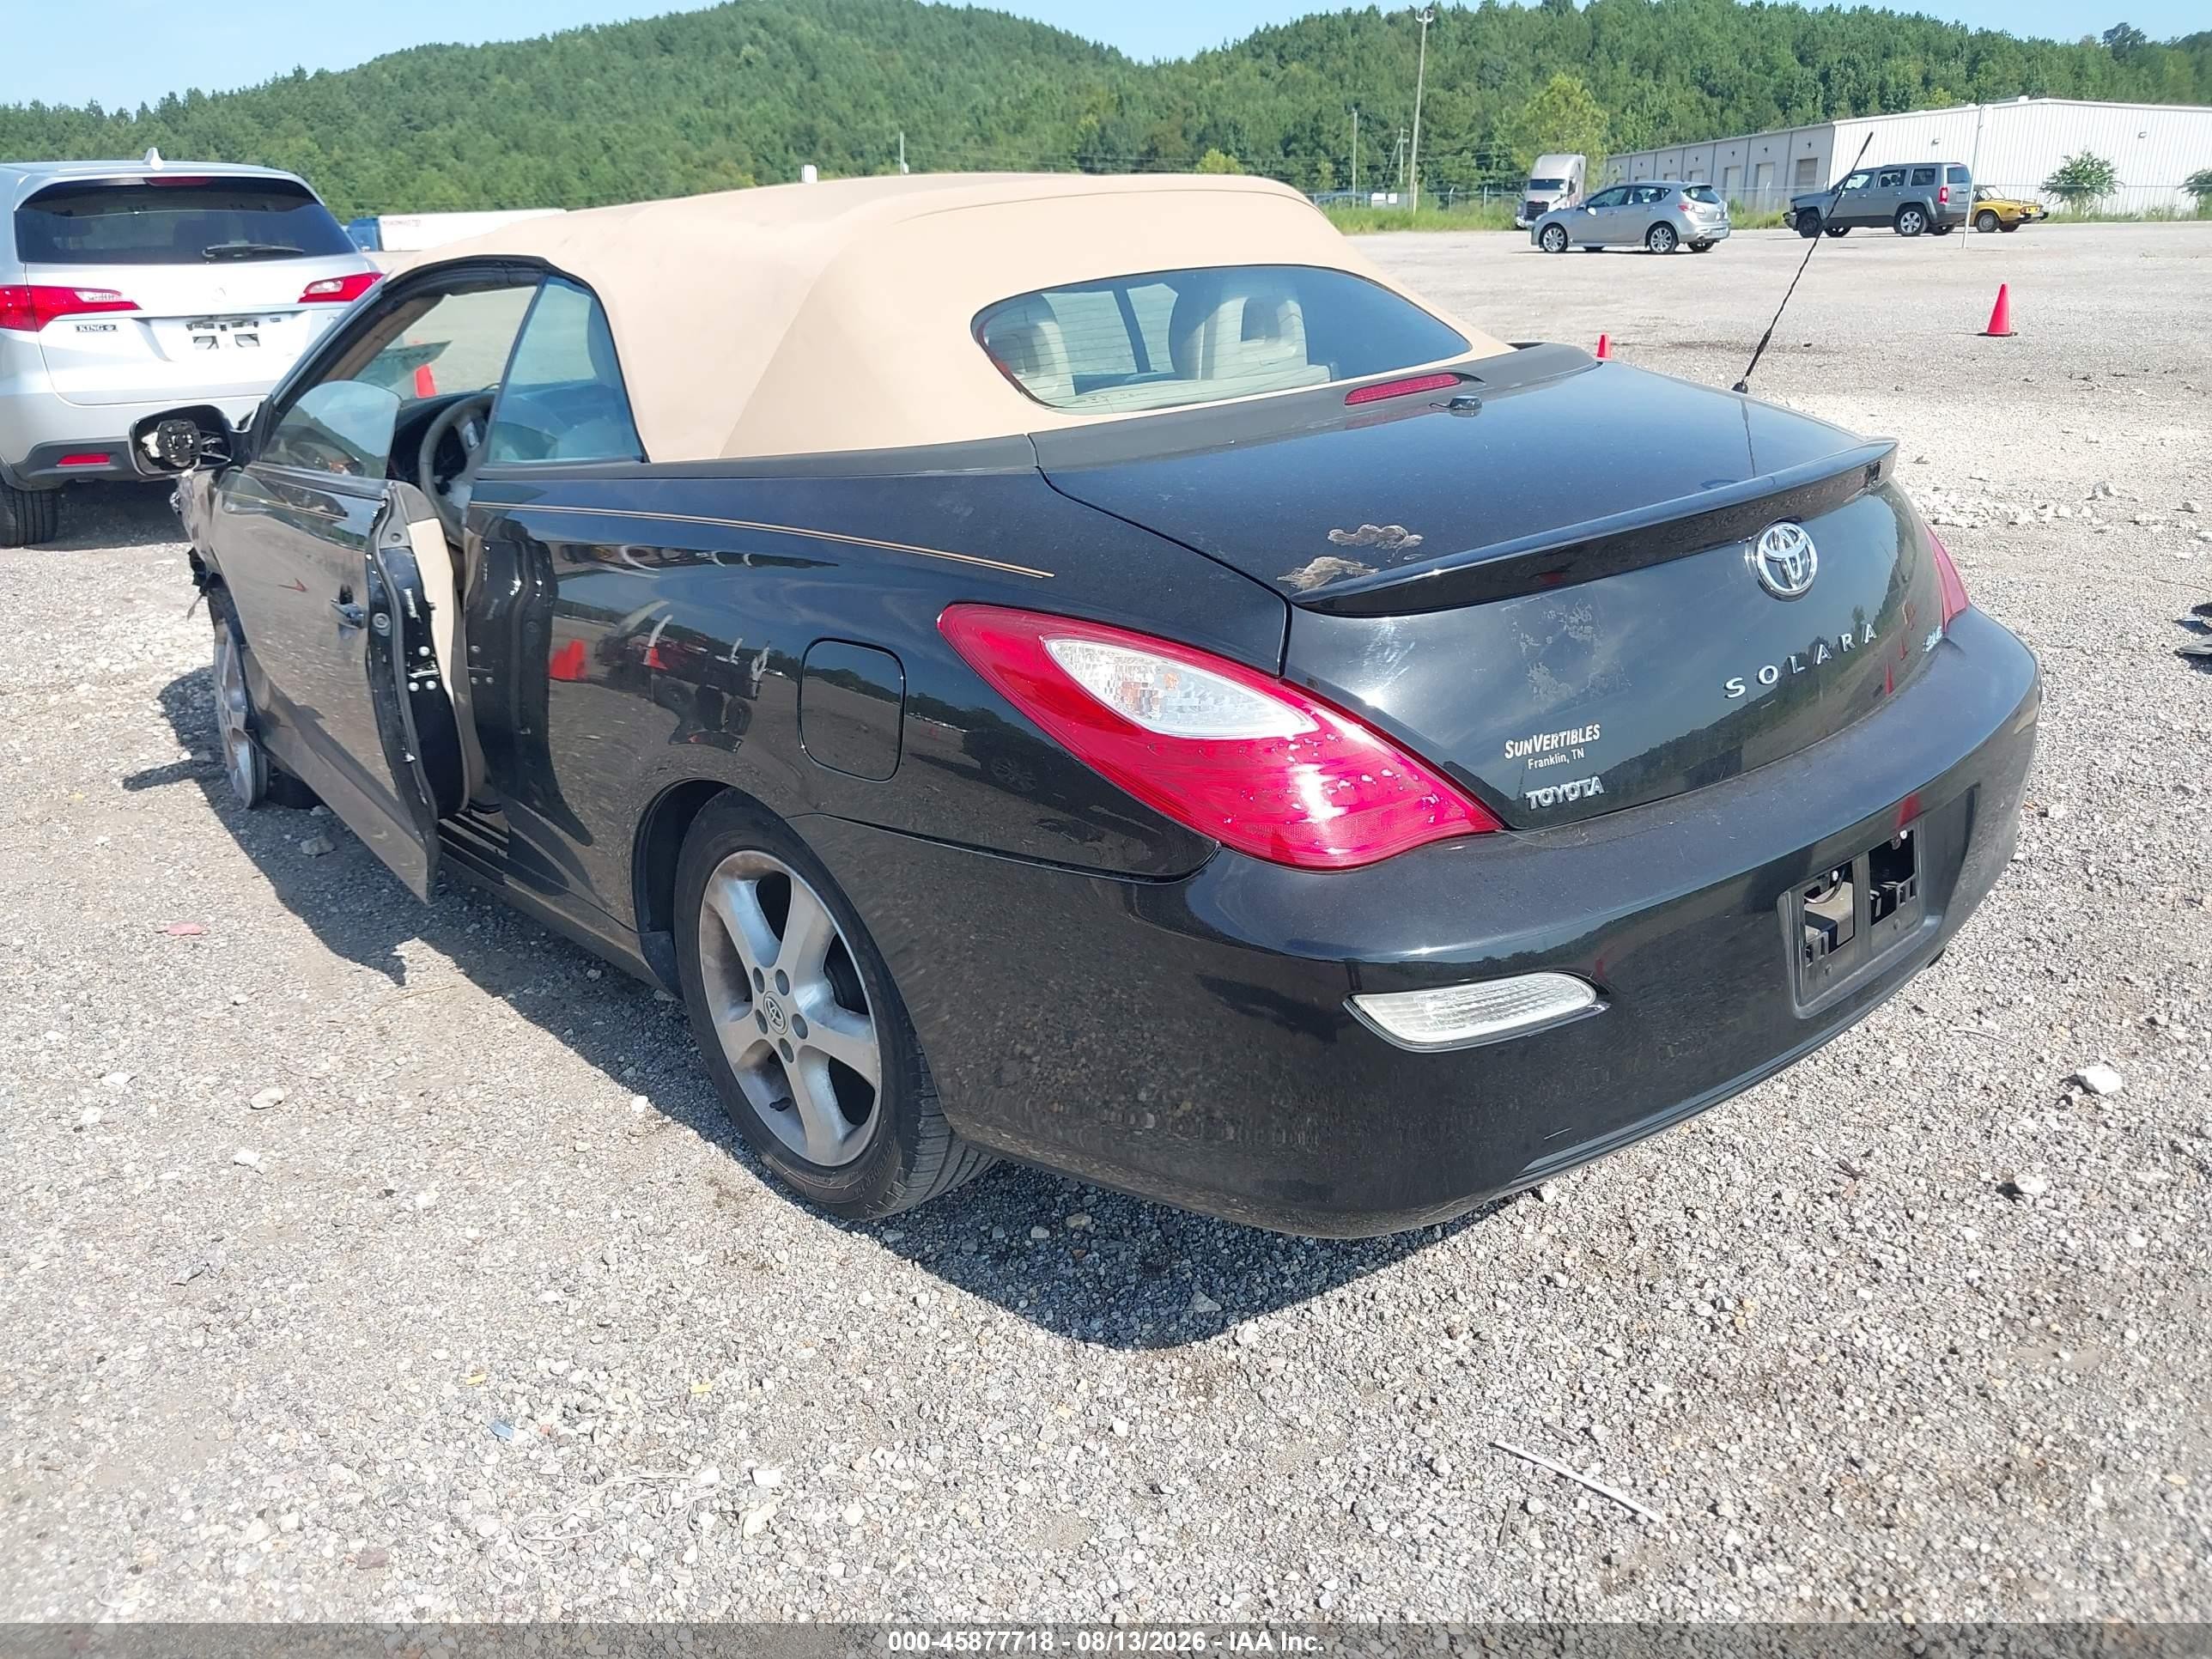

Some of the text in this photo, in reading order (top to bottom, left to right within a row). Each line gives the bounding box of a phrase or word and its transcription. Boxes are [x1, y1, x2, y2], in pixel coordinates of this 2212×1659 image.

[1724, 623, 1878, 699] SOLARA
[1528, 747, 1585, 769] Franklin, TN
[1525, 775, 1606, 811] TOYOTA
